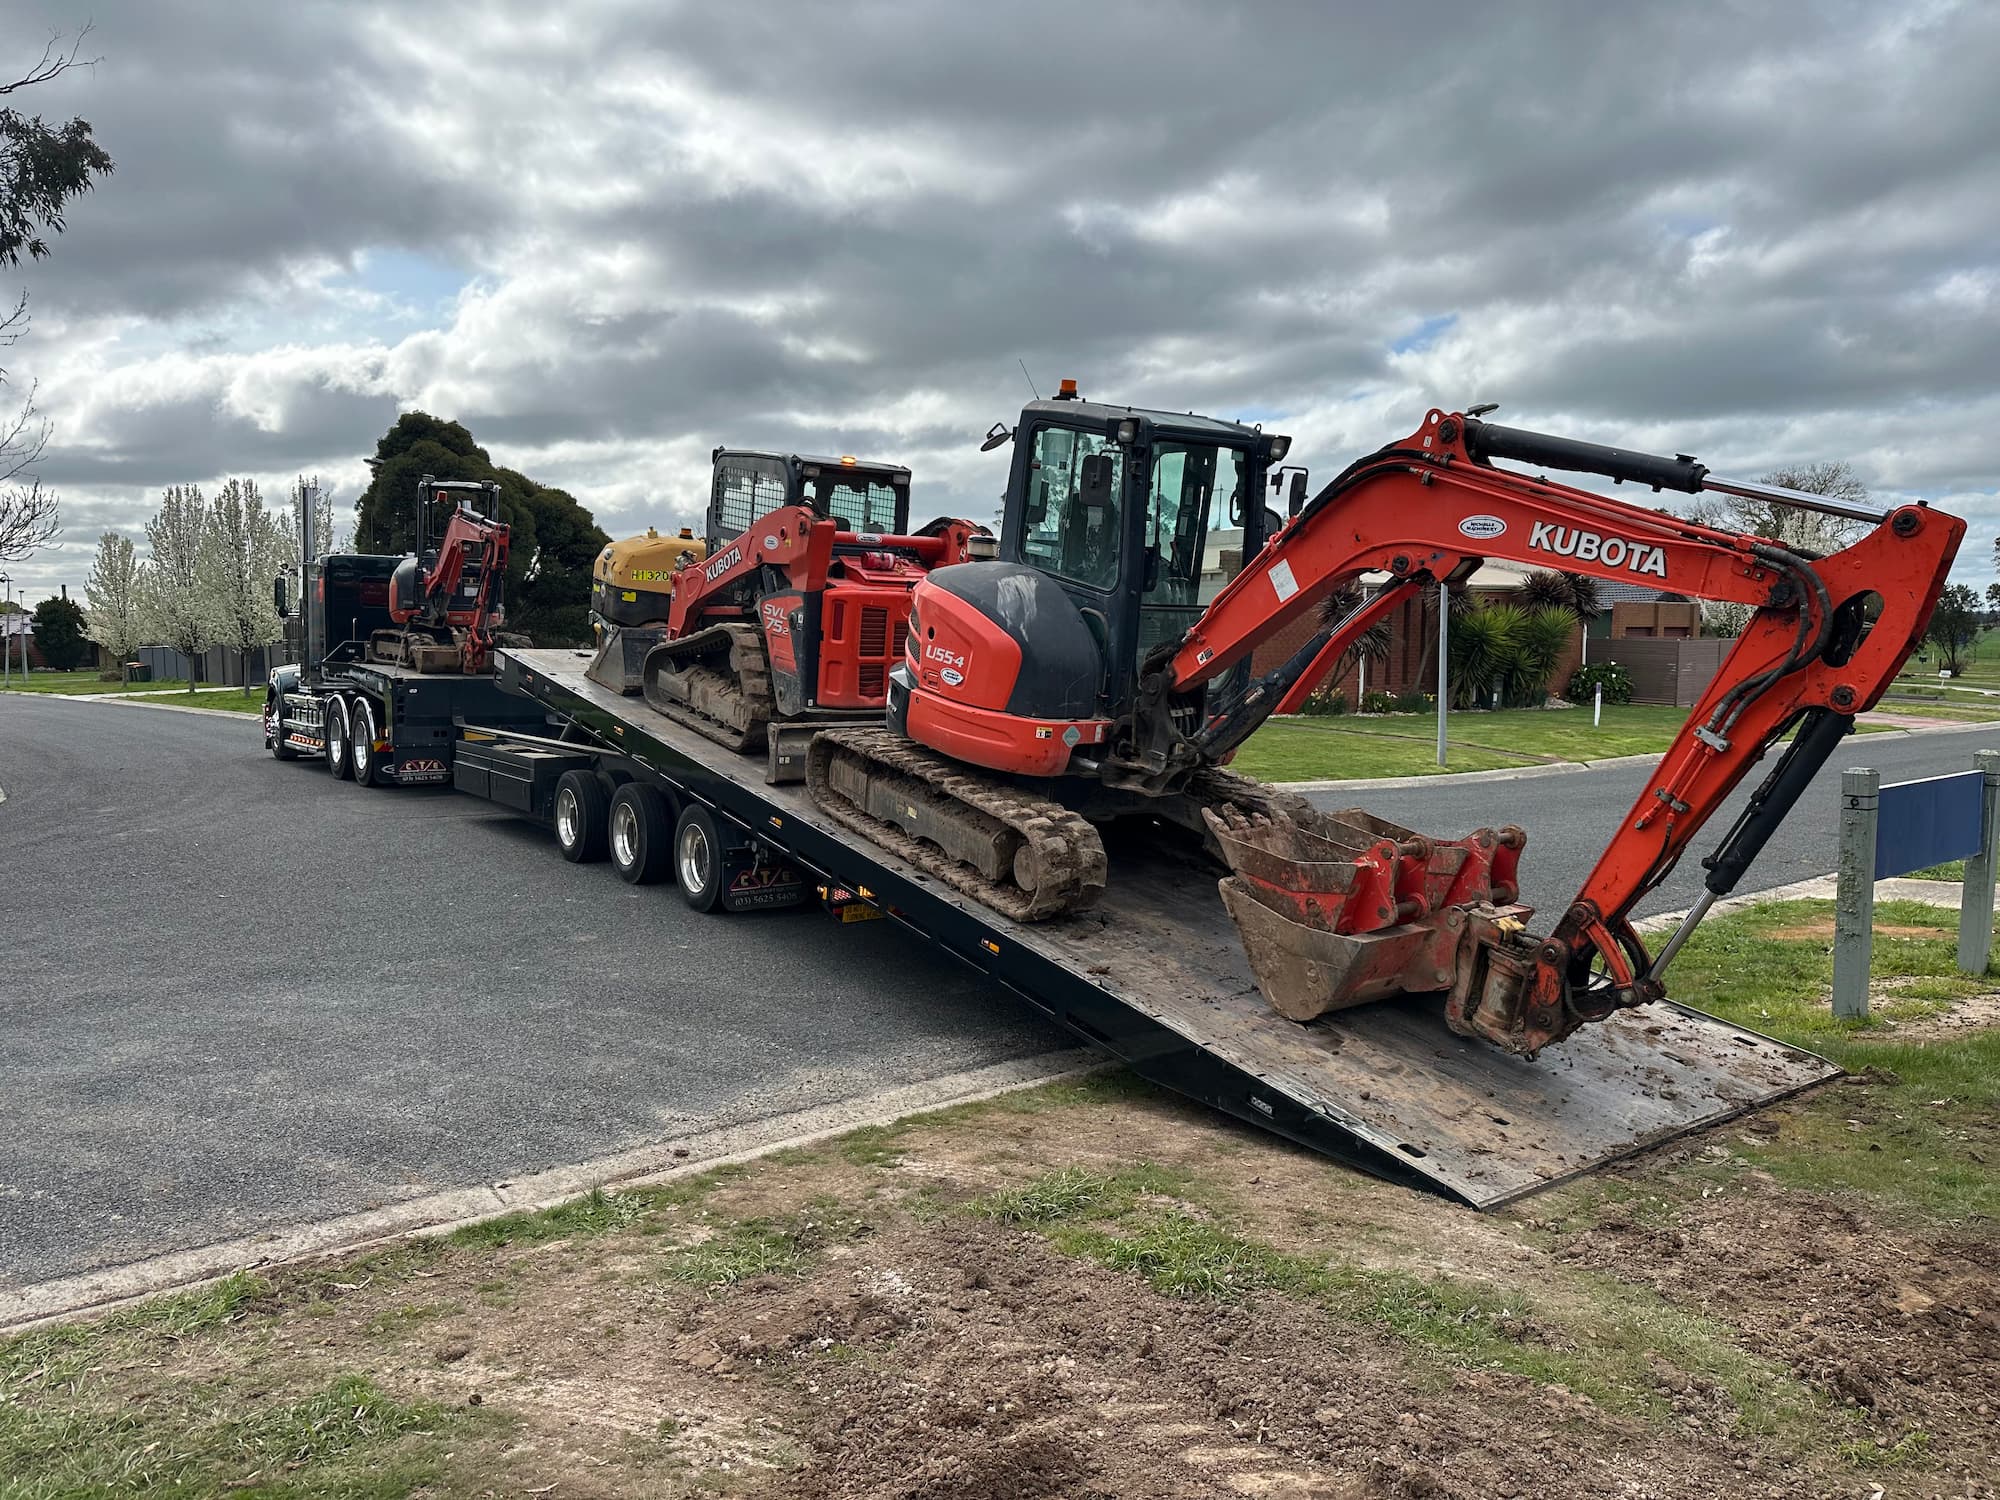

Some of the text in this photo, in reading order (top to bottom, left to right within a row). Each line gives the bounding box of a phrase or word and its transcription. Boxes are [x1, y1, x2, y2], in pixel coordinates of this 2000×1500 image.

[1528, 519, 1667, 577] KUBOTA
[705, 547, 742, 583] KUBOTA
[763, 603, 788, 620] SVL
[925, 644, 965, 668] U55-4
[753, 894, 774, 905] 5625
